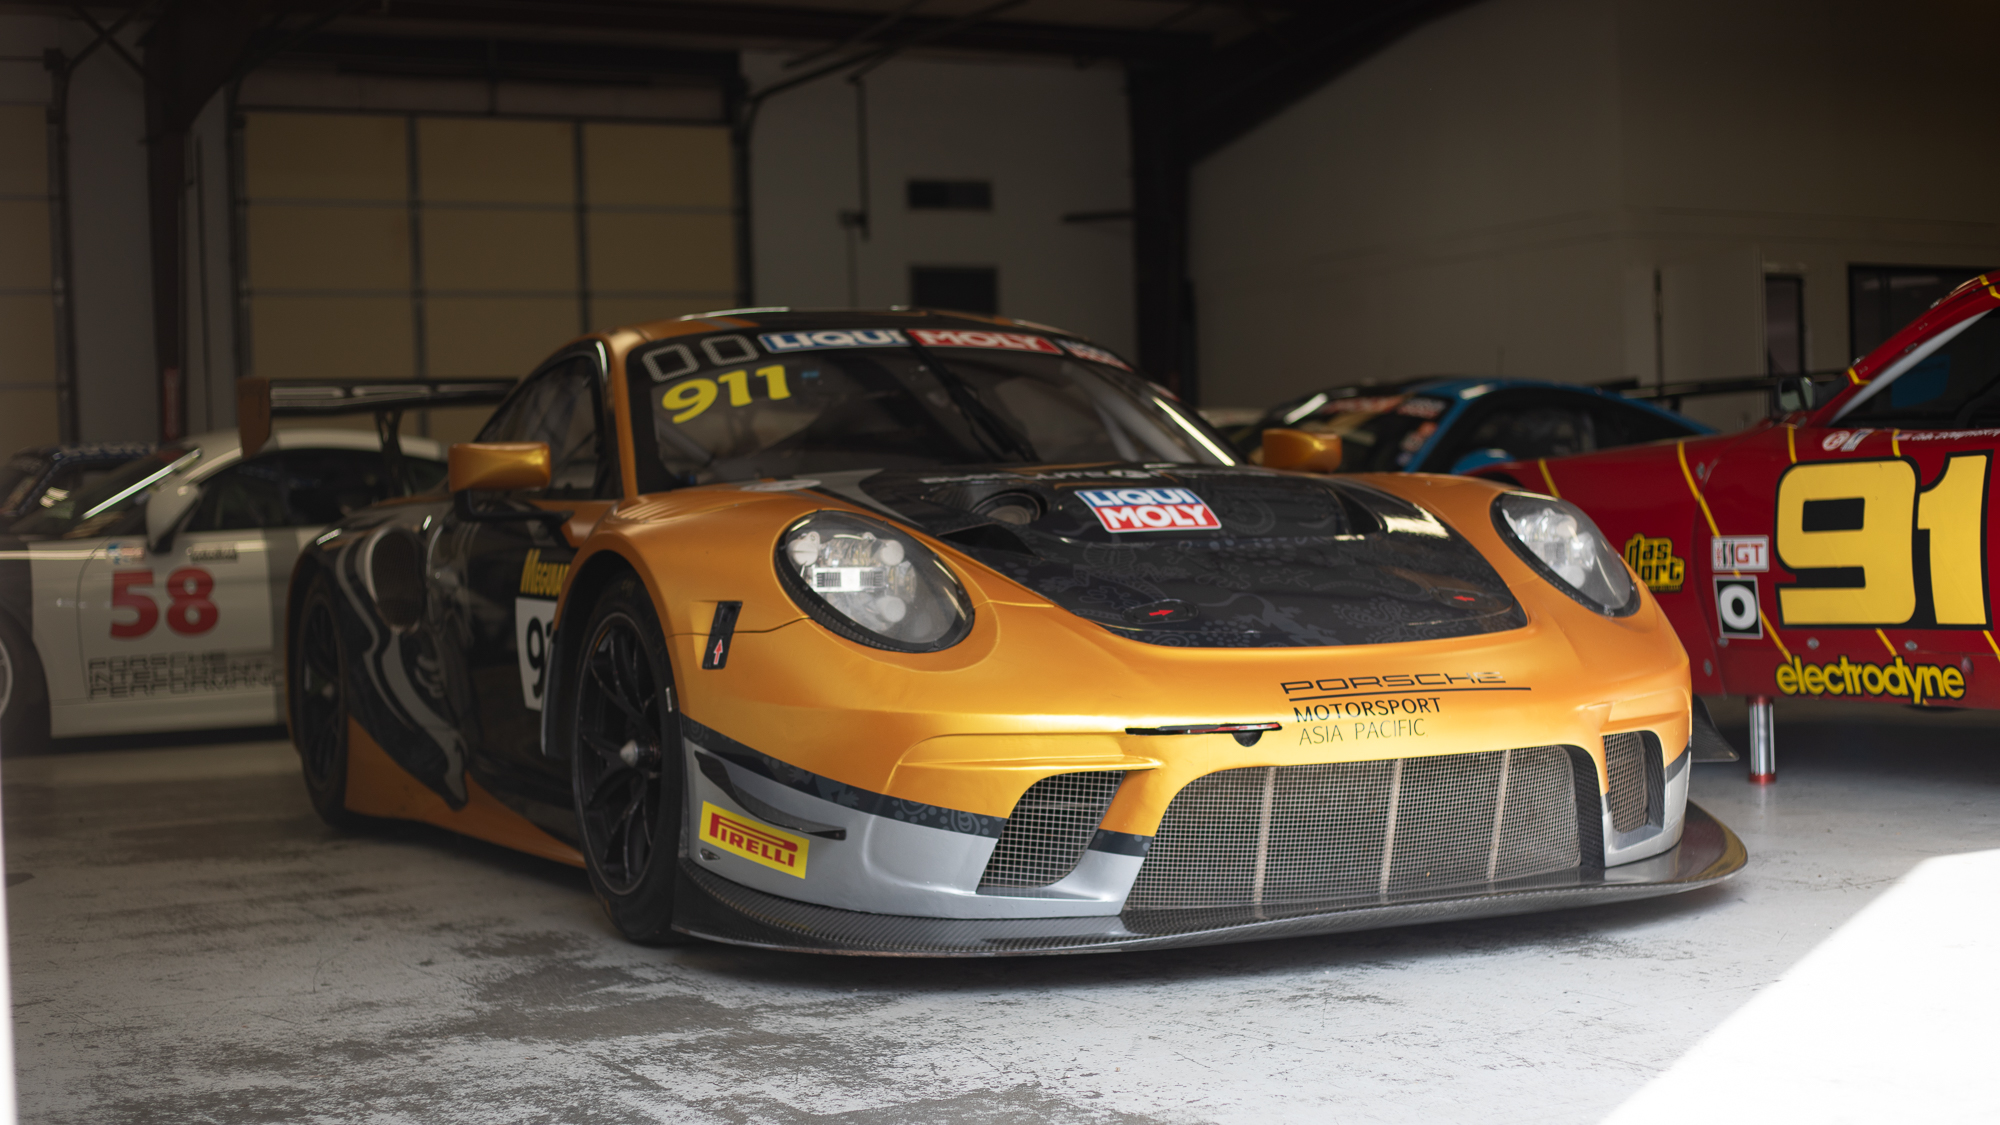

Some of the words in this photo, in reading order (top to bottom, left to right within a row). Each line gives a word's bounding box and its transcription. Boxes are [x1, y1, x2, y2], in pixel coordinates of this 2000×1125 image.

[769, 330, 908, 349] LIQUI
[915, 331, 1046, 350] MOLY
[661, 364, 792, 424] 911
[1084, 489, 1196, 506] LIQUI
[1100, 504, 1208, 529] MOLY
[1735, 543, 1764, 564] GT
[1775, 450, 1993, 630] 91
[109, 566, 219, 641] 58
[88, 653, 227, 672] PORSCHE
[527, 615, 554, 700] 9
[1280, 671, 1506, 694] PORSCHE
[1776, 655, 1966, 705] electrodyne
[1293, 697, 1441, 723] MOTORSPORT
[1299, 724, 1344, 746] ASIA
[1355, 718, 1426, 740] PACIFIC
[709, 812, 799, 868] PIRELLI
